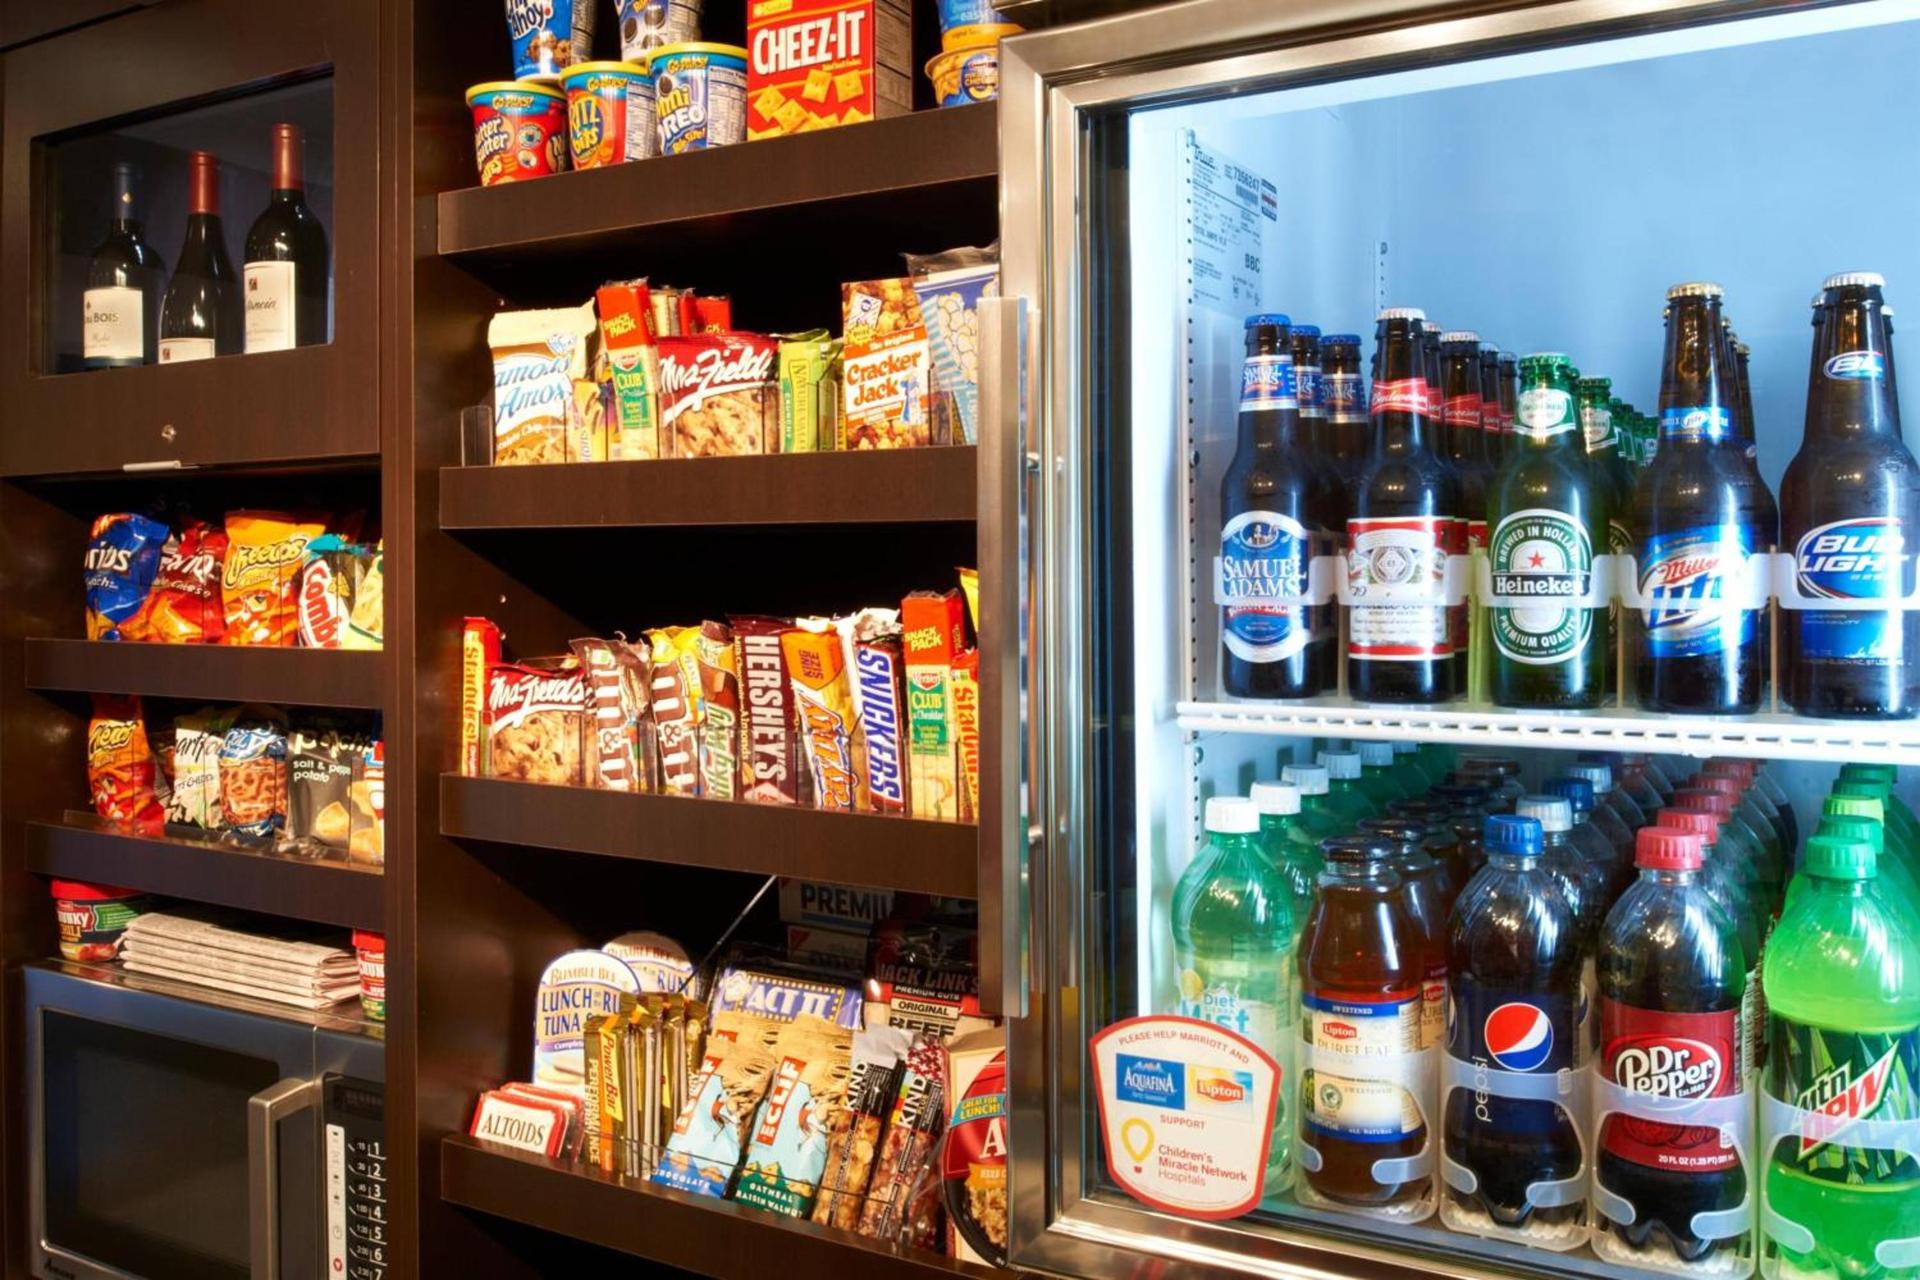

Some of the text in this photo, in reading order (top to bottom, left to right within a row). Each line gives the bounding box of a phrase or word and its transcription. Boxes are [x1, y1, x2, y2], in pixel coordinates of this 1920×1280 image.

[753, 10, 865, 75] CHEEZ-IT
[847, 352, 921, 386] Cracker
[854, 377, 899, 406] Jack
[496, 383, 565, 425] Amos
[1499, 529, 1525, 563] BREWED
[1527, 526, 1539, 537] IN
[1812, 535, 1903, 554] BUD
[1223, 556, 1307, 582] SAMUEL
[1799, 554, 1908, 573] LIGHT
[1229, 578, 1300, 598] ADAMS
[1495, 575, 1585, 595] Heineken
[1499, 614, 1578, 648] PREMIUM QUALITY
[911, 633, 942, 653] PACK
[744, 636, 788, 781] HERSHEY'S
[857, 648, 899, 800] SNICKERS
[293, 760, 314, 769] salt
[317, 761, 326, 770] &
[293, 770, 330, 783] potato
[542, 988, 592, 1012] LUNCH
[746, 984, 831, 1018] ACT II
[895, 985, 935, 996] PREMIUM
[1204, 992, 1236, 1006] Diet
[898, 1001, 950, 1016] ORIGINAL
[1332, 1005, 1373, 1015] SWEETENED
[544, 1013, 580, 1036] TUNA
[1324, 1024, 1356, 1038] Lipton
[1118, 1030, 1250, 1065] PLEASE HELP MARRIOTT AND
[1649, 1045, 1690, 1075] Dr
[602, 1033, 618, 1113] PowerBar
[1124, 1066, 1175, 1094] AQUAFINA
[1620, 1048, 1714, 1103] Pepper
[841, 1061, 869, 1112] KIND
[1199, 1080, 1241, 1099] Lipton
[1472, 1055, 1492, 1123] pepsi
[1800, 1069, 1848, 1112] Mtn
[892, 1076, 927, 1129] KIND
[481, 1112, 545, 1147] ALTOIDS
[1160, 1114, 1206, 1130] SUPPORT
[373, 1142, 380, 1155] 1
[1158, 1144, 1214, 1163] Children's
[1658, 1154, 1668, 1162] 20
[1669, 1155, 1678, 1164] FL
[1679, 1157, 1689, 1165] OZ
[373, 1163, 381, 1177] 2
[1158, 1156, 1248, 1182] Miracle Network
[1158, 1169, 1206, 1187] Hospitals
[374, 1184, 381, 1197] 3
[749, 1181, 794, 1203] OATMEAL
[374, 1206, 381, 1219] 4
[374, 1226, 382, 1240] 5
[375, 1248, 383, 1261] 6
